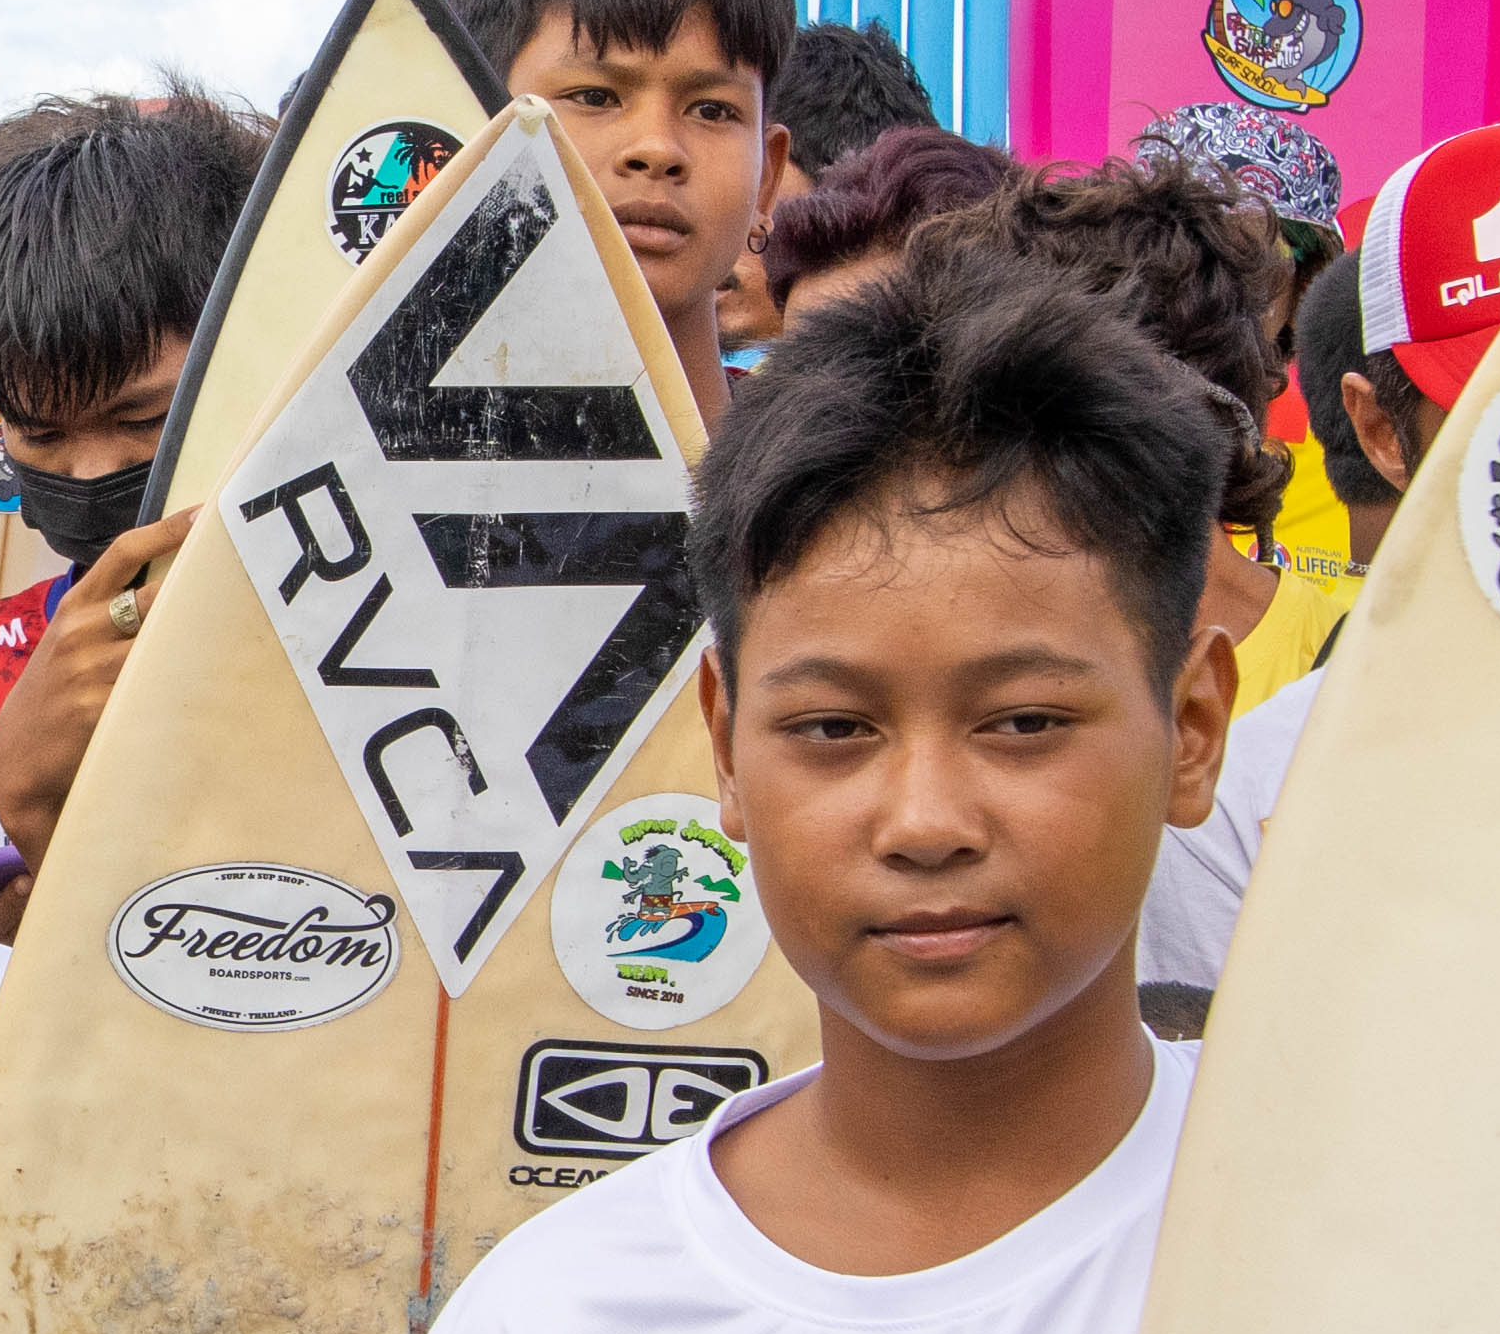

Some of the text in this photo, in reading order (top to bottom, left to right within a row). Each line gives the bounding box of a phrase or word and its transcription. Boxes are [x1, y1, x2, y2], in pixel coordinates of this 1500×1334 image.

[1215, 47, 1278, 96] SURF SCHOOL
[380, 188, 409, 204] reef
[1295, 554, 1340, 578] LIFEG
[220, 872, 305, 886] SURF & SUP SHOP
[124, 893, 397, 968] Freedom
[625, 985, 685, 1004] SINCE 2018
[202, 1005, 297, 1020] PHUKET THAILAND
